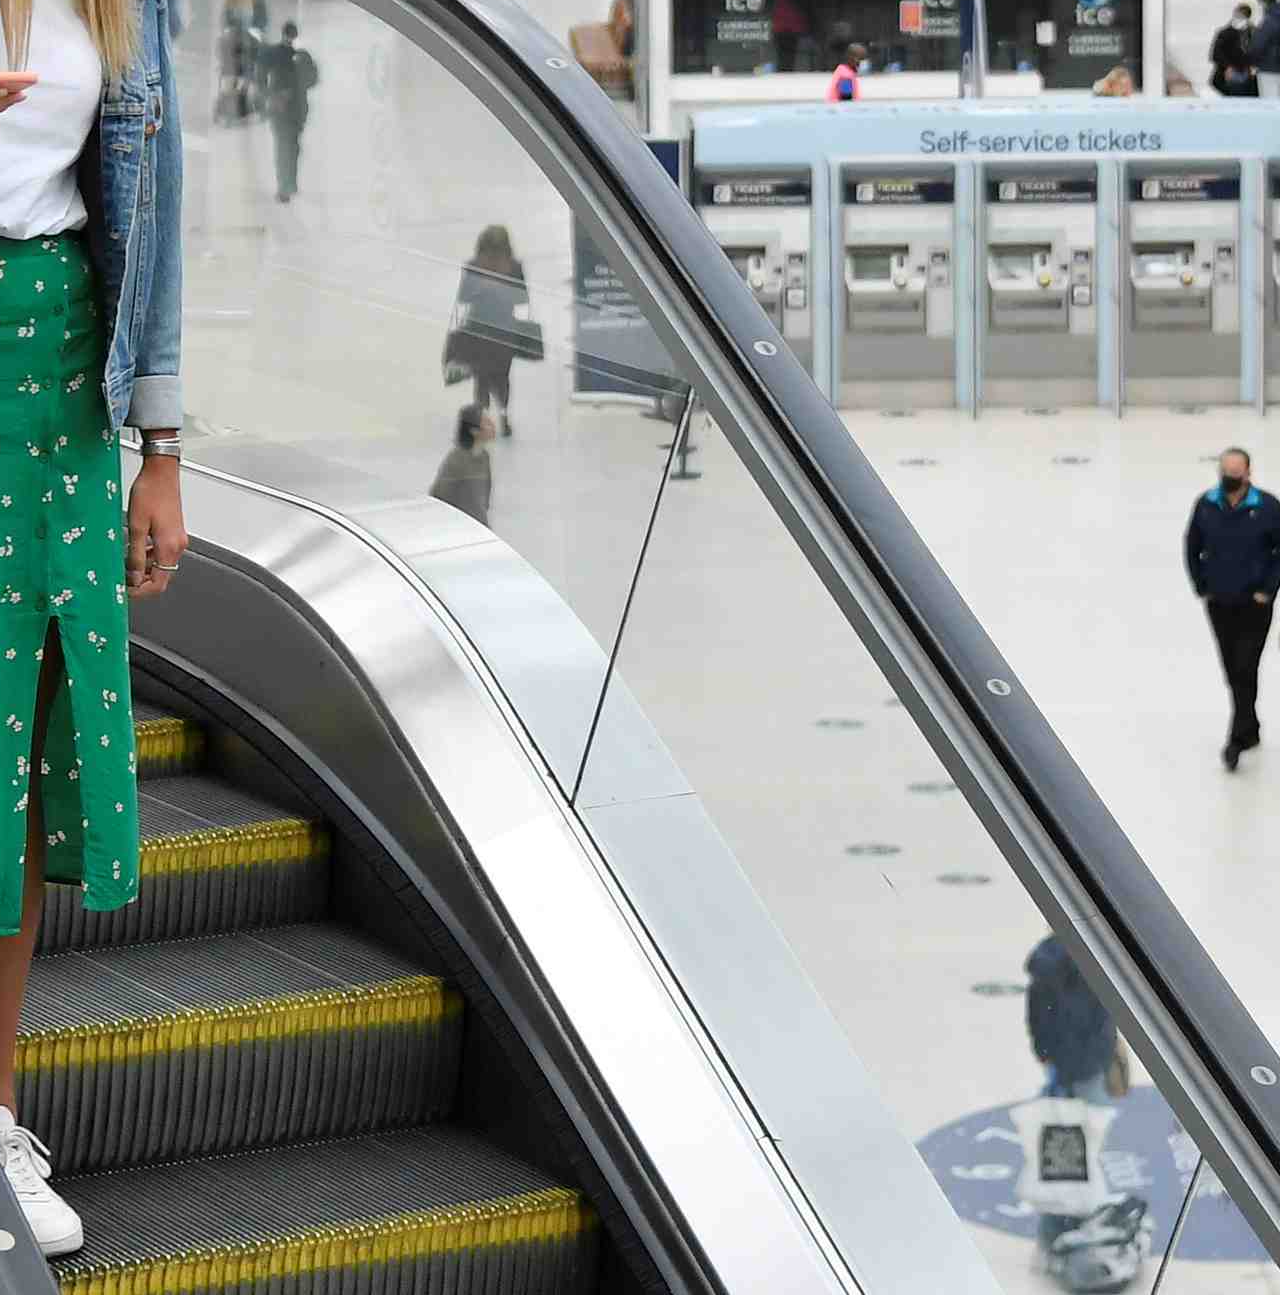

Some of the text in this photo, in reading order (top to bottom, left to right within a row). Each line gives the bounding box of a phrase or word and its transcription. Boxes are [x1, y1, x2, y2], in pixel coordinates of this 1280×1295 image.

[1075, 4, 1115, 25] ice
[919, 129, 1162, 153] Self-service tickets
